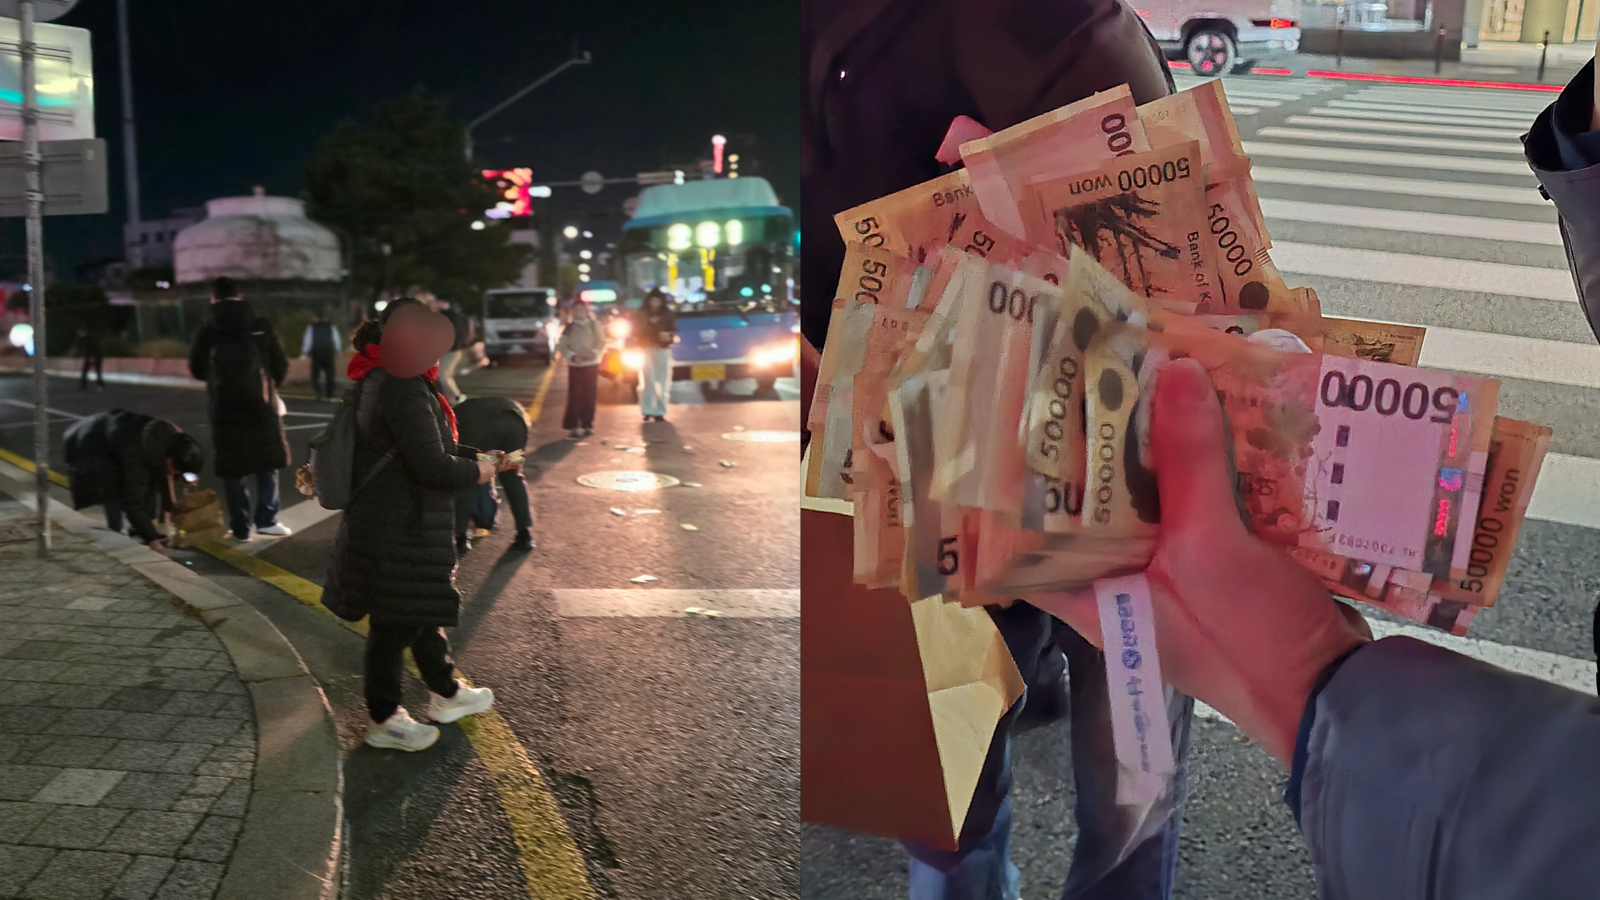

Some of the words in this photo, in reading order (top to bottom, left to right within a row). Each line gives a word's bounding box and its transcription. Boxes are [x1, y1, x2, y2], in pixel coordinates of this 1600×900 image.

[932, 183, 974, 207] Bank
[1069, 176, 1112, 195] won
[1117, 156, 1191, 191] 50000
[1187, 230, 1203, 270] Bank
[1206, 203, 1253, 276] 50000
[1040, 356, 1079, 463] 50000
[1319, 369, 1460, 424] 50000
[1459, 516, 1504, 594] 50000
[1494, 467, 1521, 512] won
